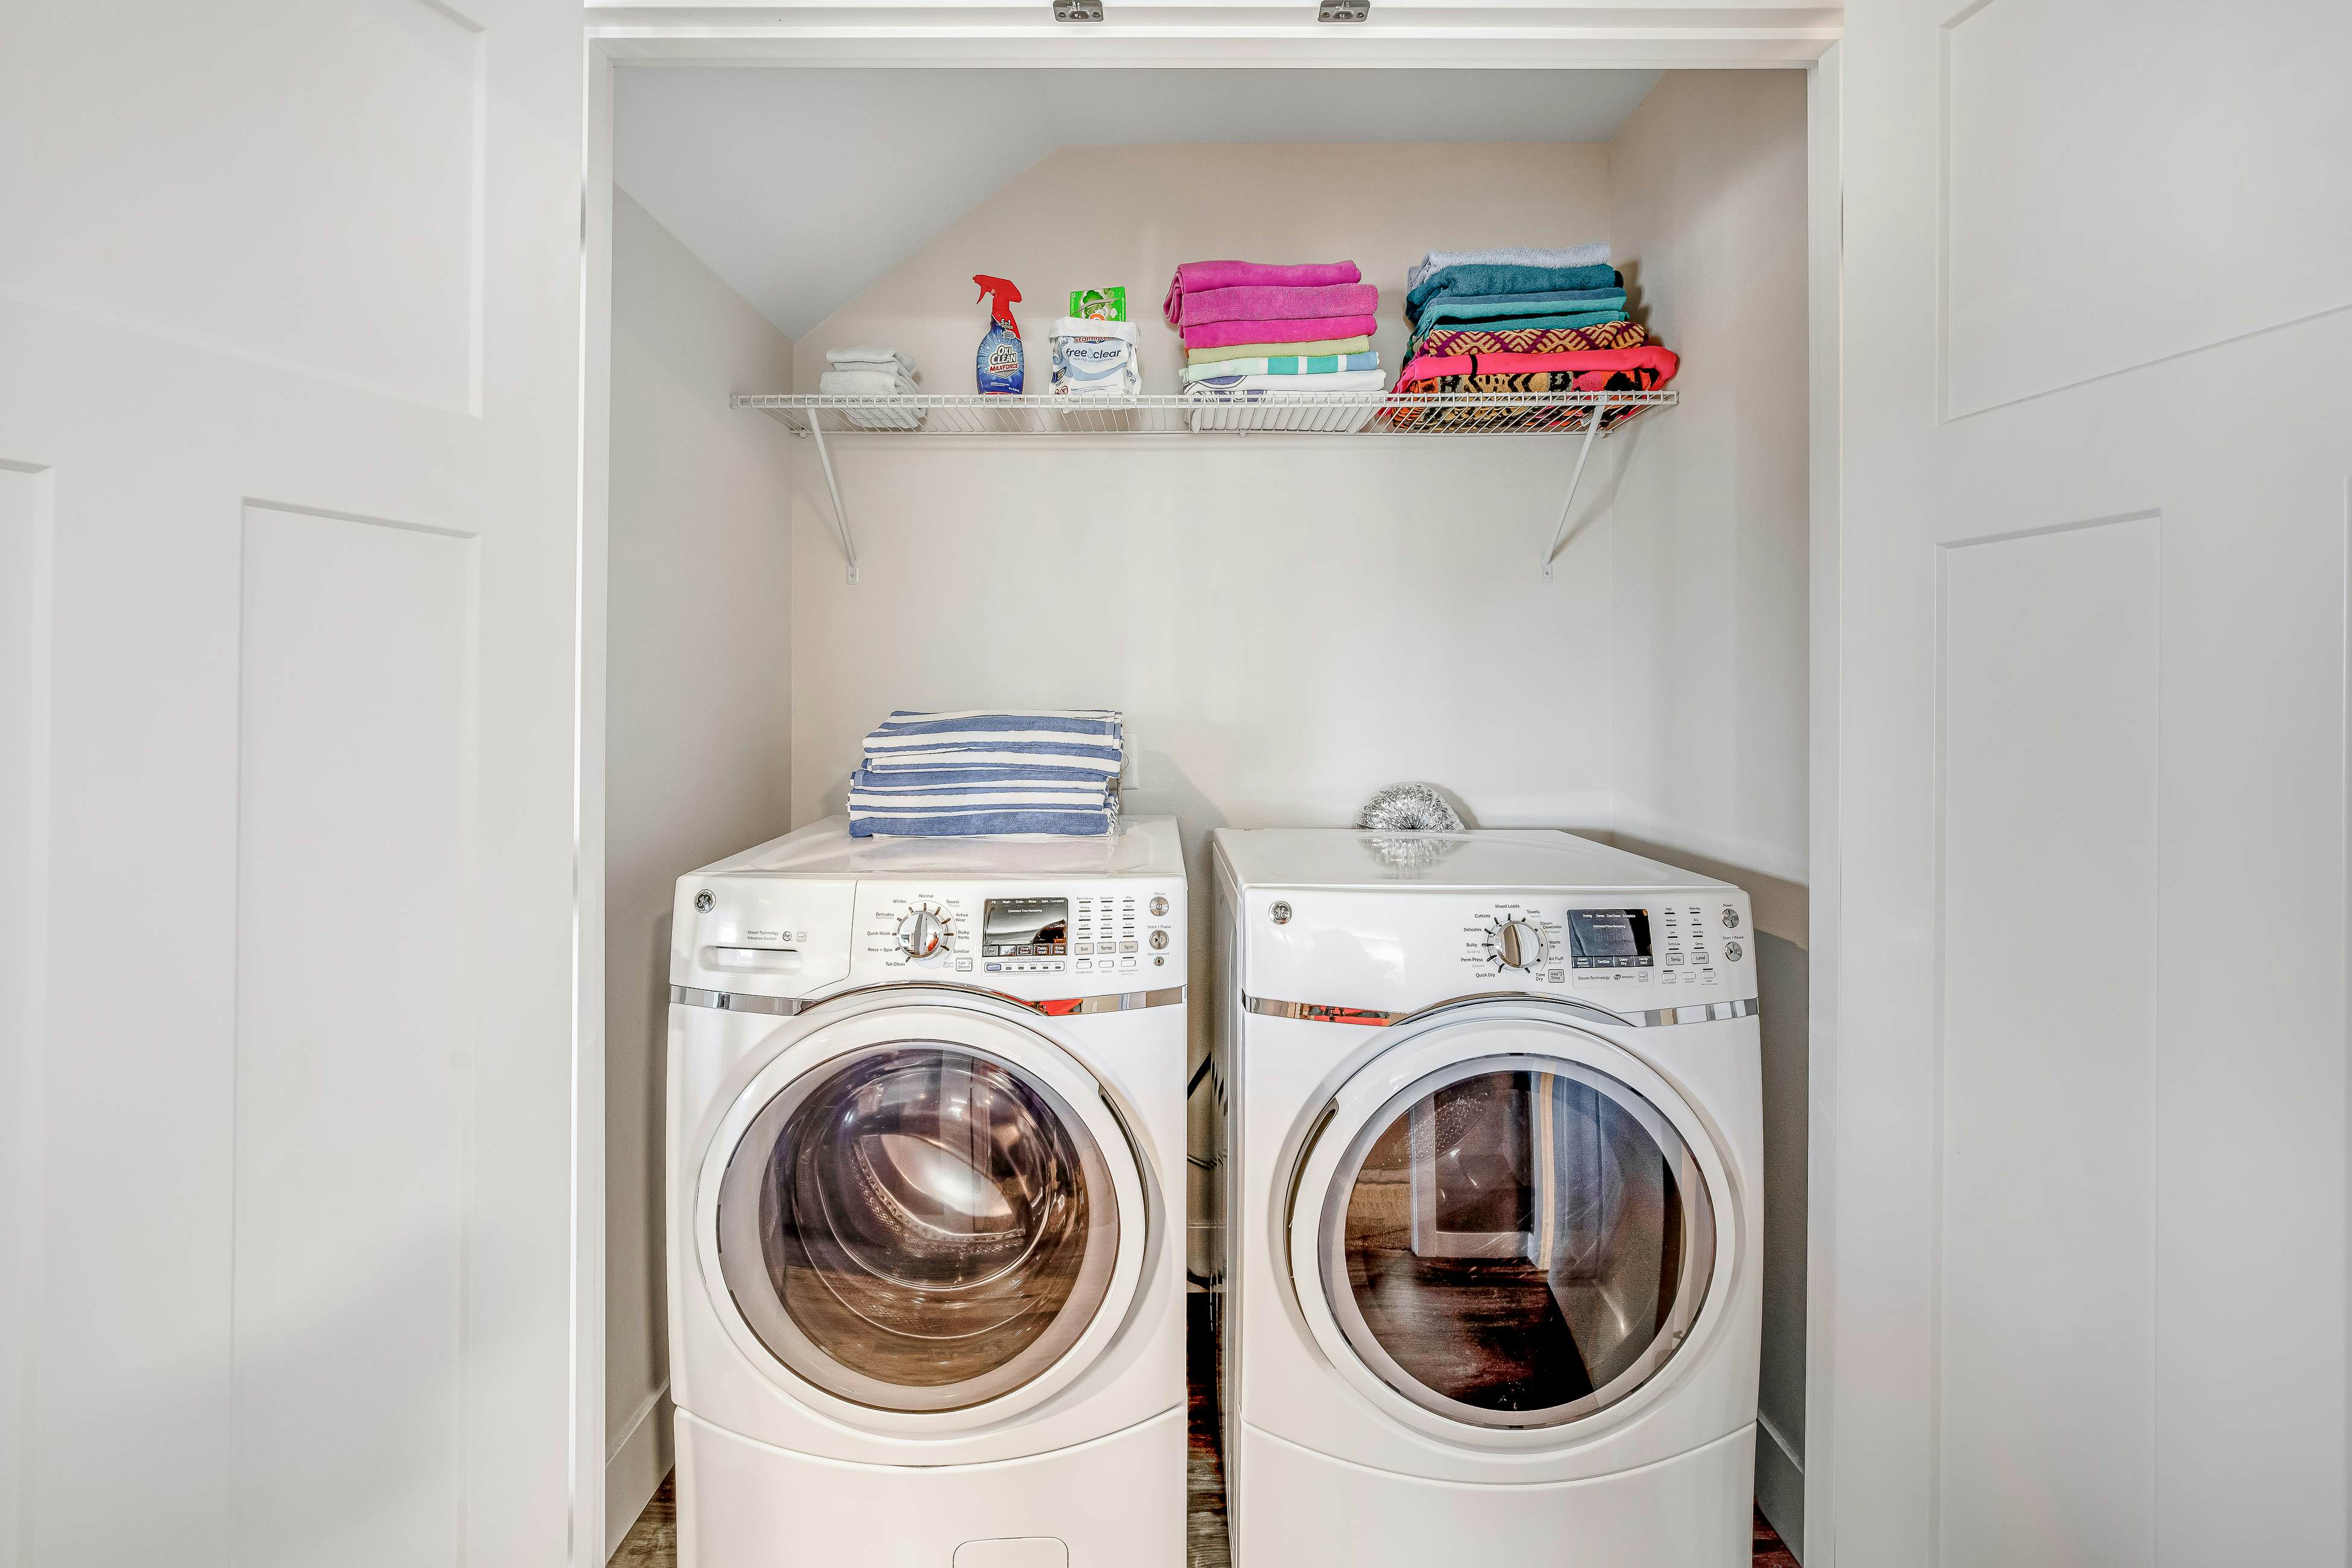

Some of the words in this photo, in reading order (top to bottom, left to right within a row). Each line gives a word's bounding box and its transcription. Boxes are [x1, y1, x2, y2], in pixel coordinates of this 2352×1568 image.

[991, 353, 1017, 365] CLEAN
[1066, 348, 1087, 357] free
[1093, 350, 1121, 359] clear
[990, 363, 1018, 371] MAXFORCE
